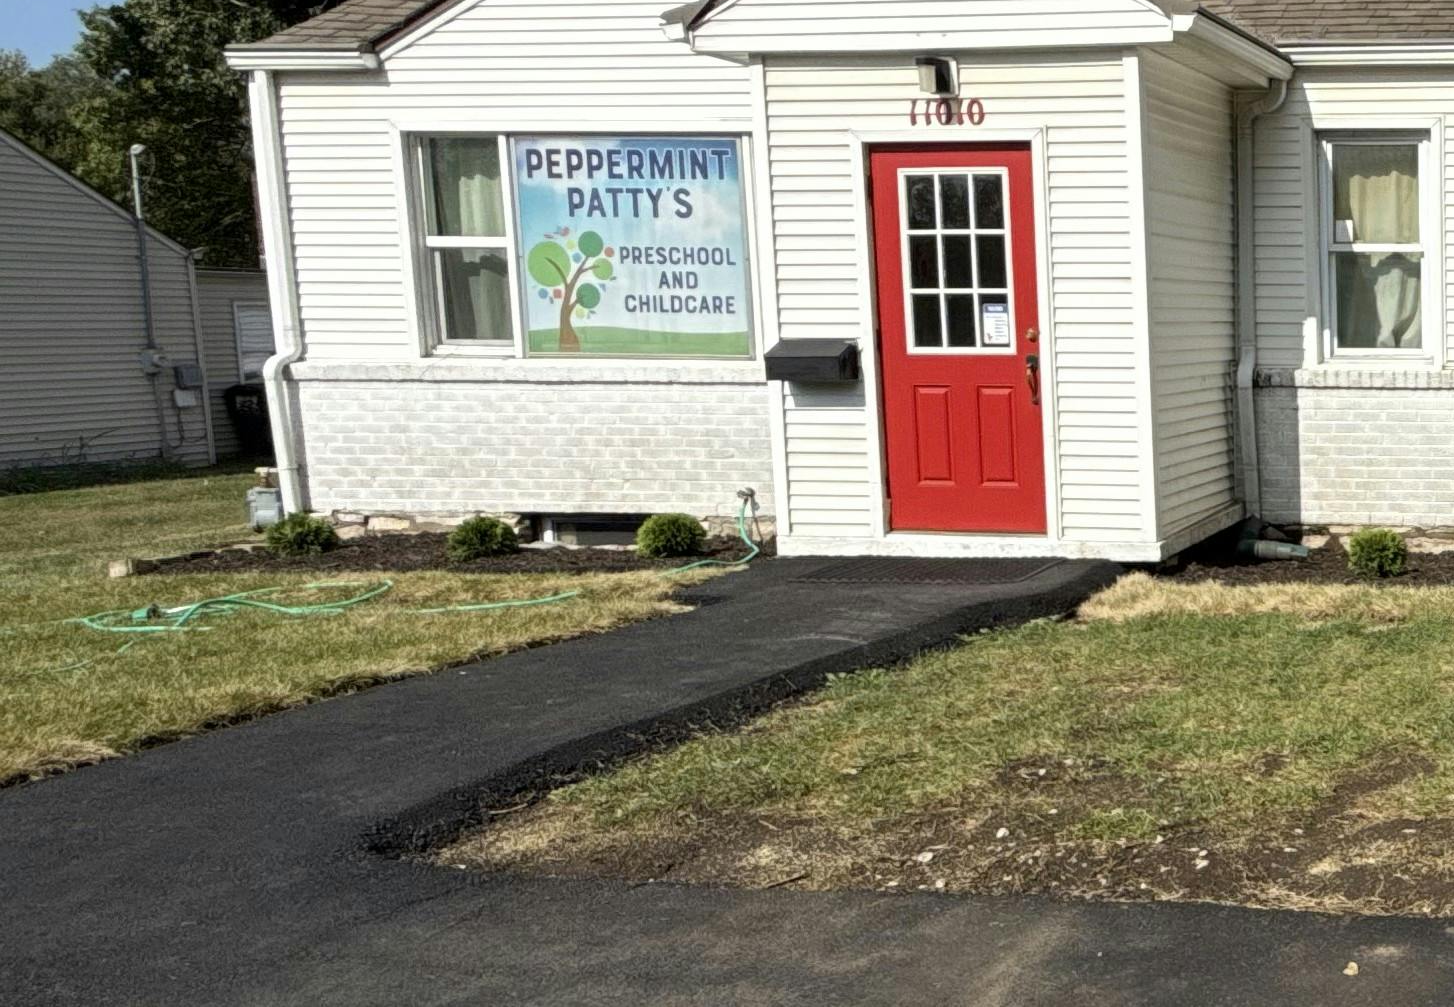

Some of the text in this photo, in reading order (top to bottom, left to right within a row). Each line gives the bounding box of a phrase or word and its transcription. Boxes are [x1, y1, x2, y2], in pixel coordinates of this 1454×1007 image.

[910, 98, 985, 126] 11010
[525, 148, 730, 180] PEPPERMINT
[567, 186, 693, 218] PATTY'S
[619, 246, 737, 266] PRESCHOOL
[658, 271, 698, 290] AND
[624, 294, 736, 314] CHILDCARE
